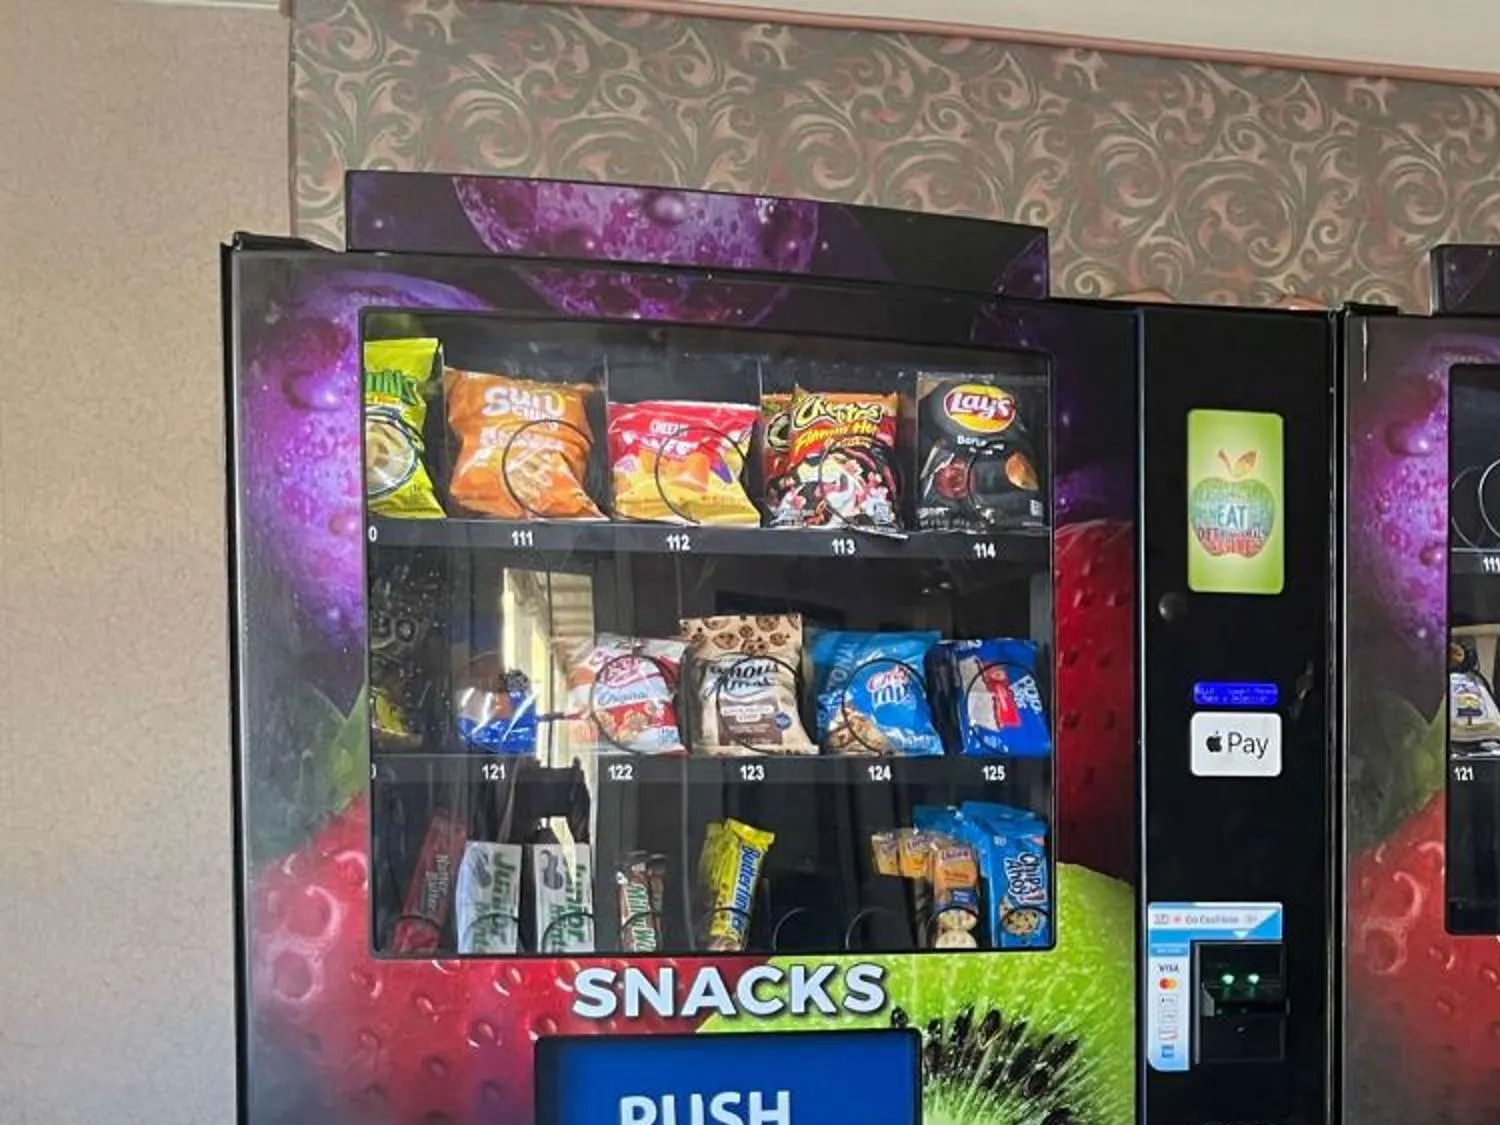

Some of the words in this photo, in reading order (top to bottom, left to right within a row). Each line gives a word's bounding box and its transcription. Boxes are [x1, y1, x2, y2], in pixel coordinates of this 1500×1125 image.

[951, 392, 1010, 419] Lay's
[511, 531, 533, 547] 111
[666, 533, 691, 551] 112
[831, 538, 856, 555] 113
[973, 541, 997, 559] 114
[1227, 731, 1269, 760] Pay
[481, 764, 506, 781] 121
[608, 764, 633, 781] 122
[740, 764, 765, 781] 123
[868, 765, 891, 781] 124
[983, 765, 1005, 781] 125
[1454, 766, 1474, 781] 121
[573, 963, 887, 1019] SNACKS
